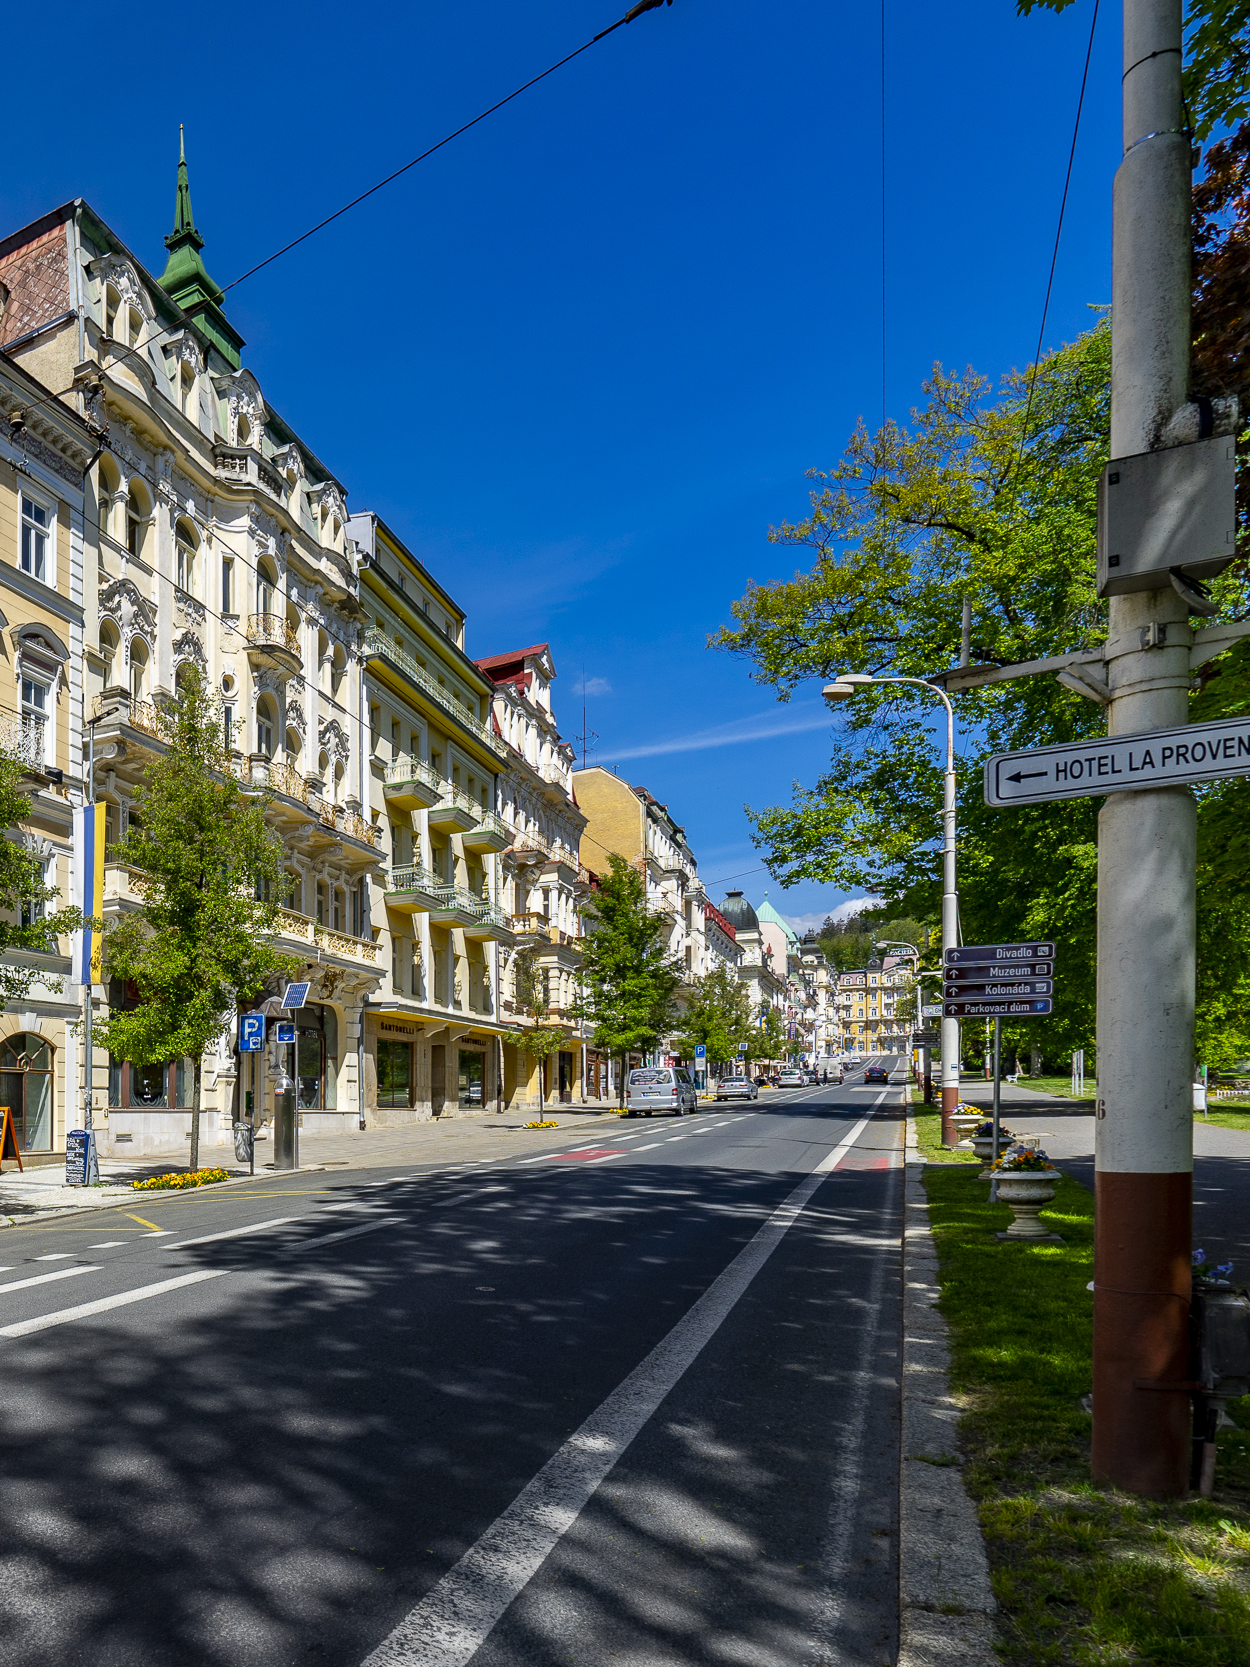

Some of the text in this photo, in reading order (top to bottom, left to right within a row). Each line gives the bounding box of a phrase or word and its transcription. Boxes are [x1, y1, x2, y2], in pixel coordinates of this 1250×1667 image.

[1055, 734, 1250, 782] HOTEL LA PROVEN
[996, 948, 1032, 958] Divadlo
[990, 967, 1031, 976] Muzeum
[985, 983, 1030, 995] Kolonáda
[964, 1002, 1030, 1013] Parkovací dům
[244, 1019, 259, 1040] P
[697, 1047, 703, 1055] P
